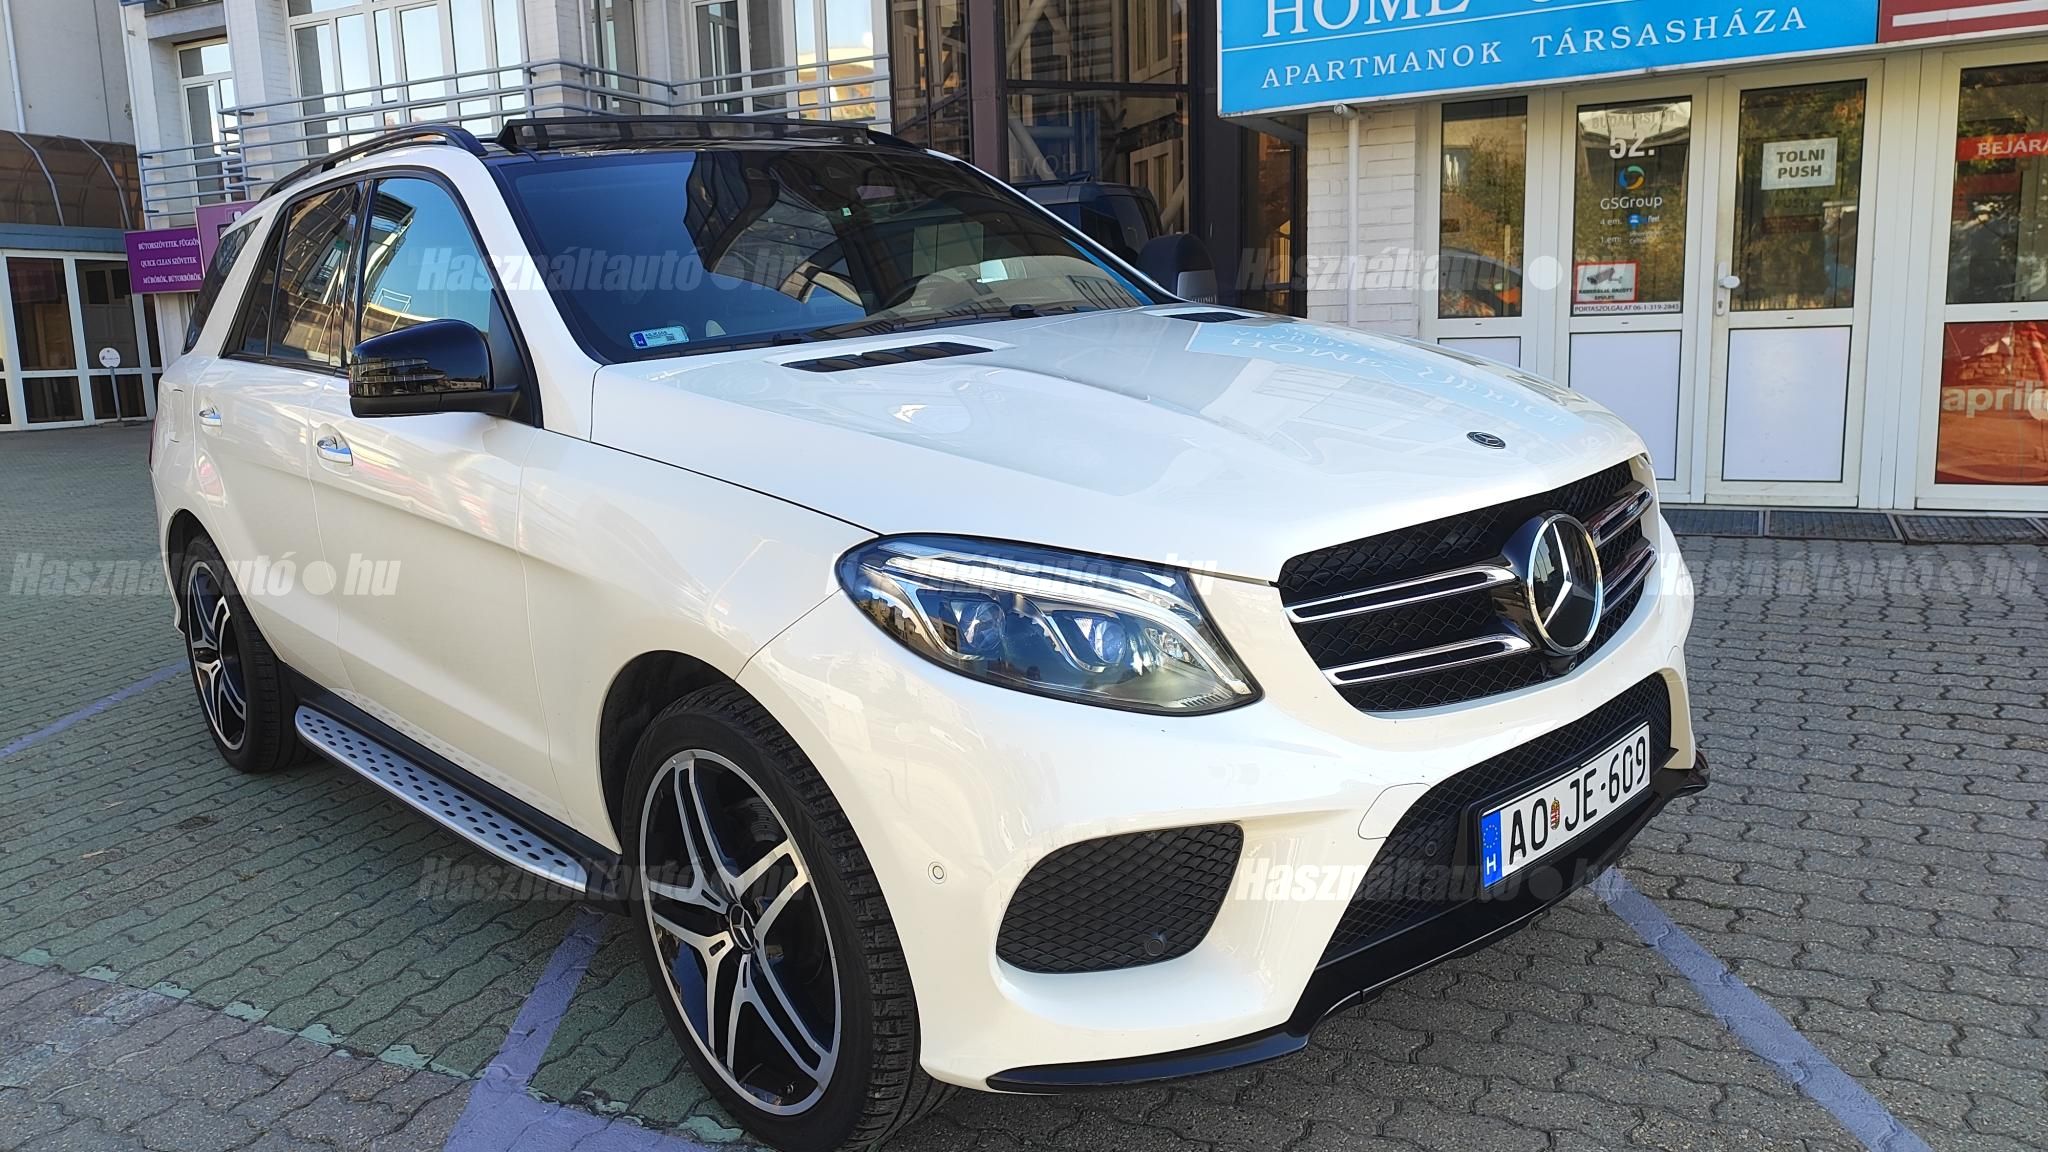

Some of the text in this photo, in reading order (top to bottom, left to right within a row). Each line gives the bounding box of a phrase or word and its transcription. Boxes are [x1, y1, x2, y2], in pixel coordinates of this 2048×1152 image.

[1261, 7, 1806, 89] APARTMANOK TÁRSASHÁZA
[1608, 130, 1655, 159] 52.
[1776, 149, 1825, 163] TOLNI
[1777, 165, 1822, 179] PUSH
[1600, 196, 1663, 210] GSGroup
[1509, 735, 1646, 865] AO JE-609
[1486, 853, 1497, 875] H
